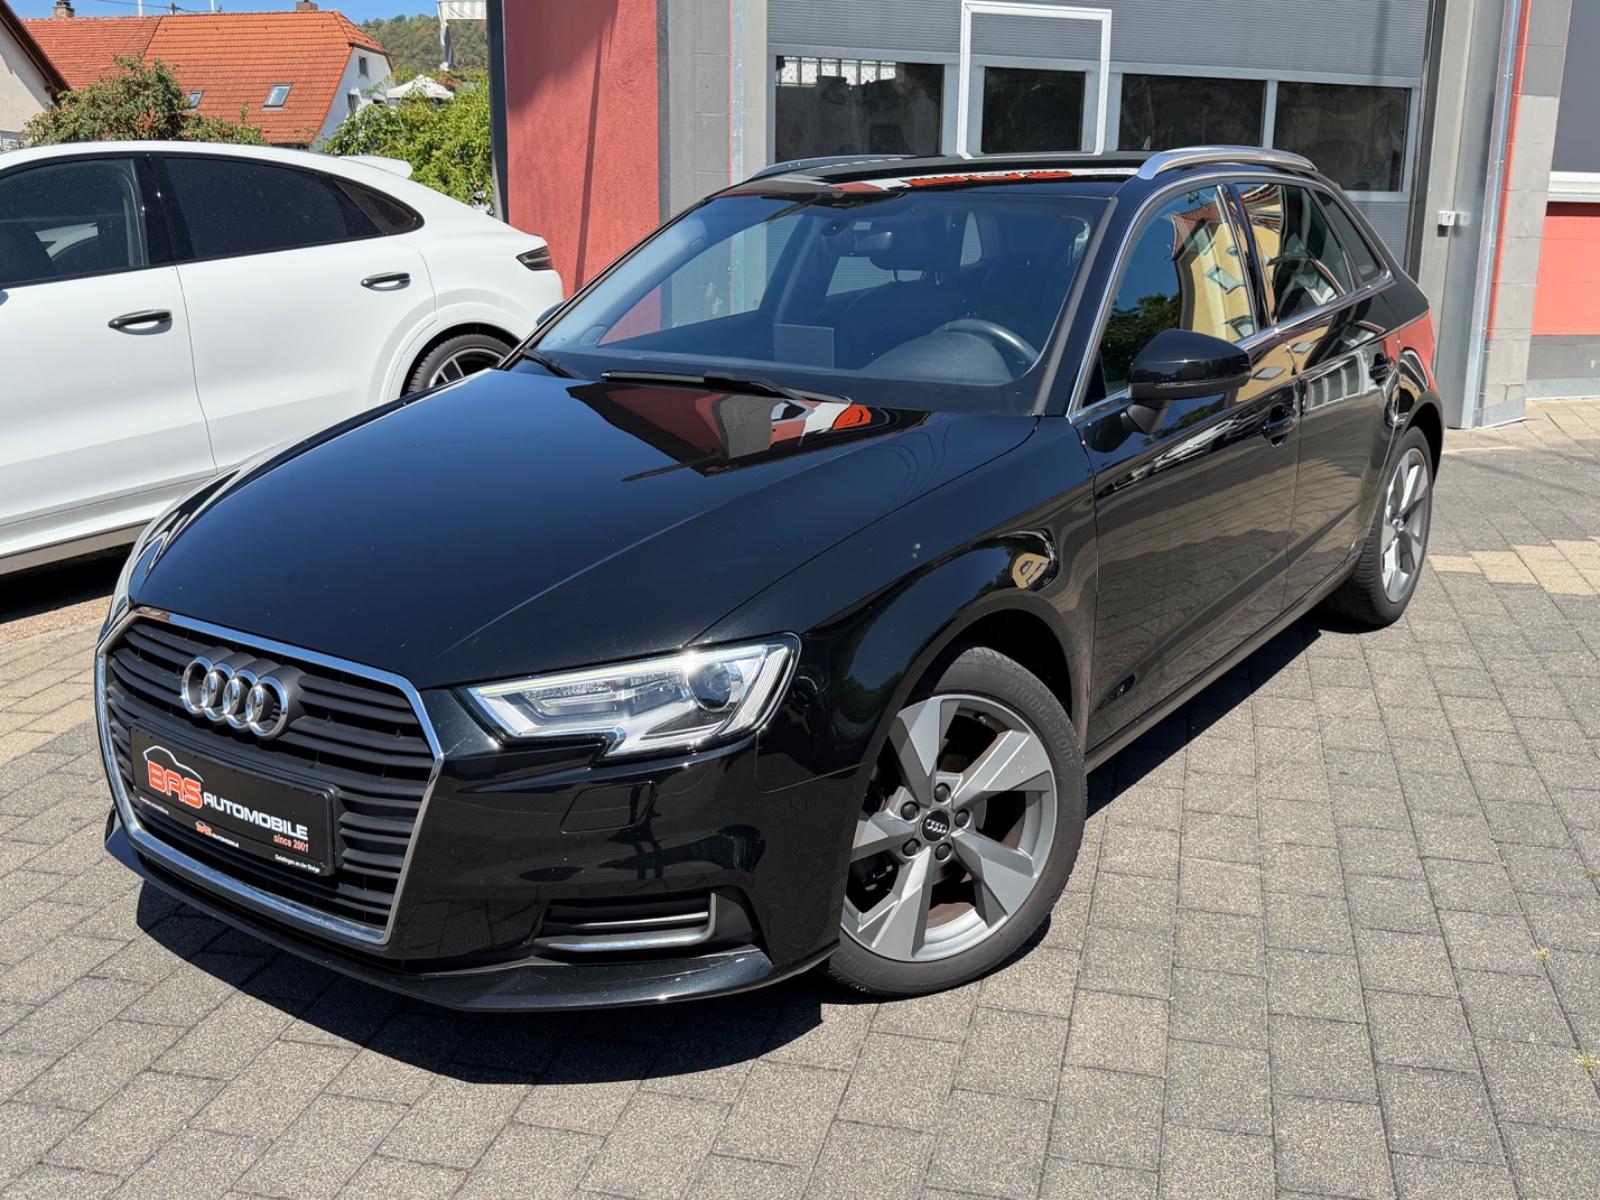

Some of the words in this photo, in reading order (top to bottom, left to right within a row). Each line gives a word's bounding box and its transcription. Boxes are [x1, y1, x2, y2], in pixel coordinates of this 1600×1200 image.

[203, 792, 309, 841] AUTOMOBILE
[273, 834, 292, 848] since
[292, 839, 309, 853] 2001
